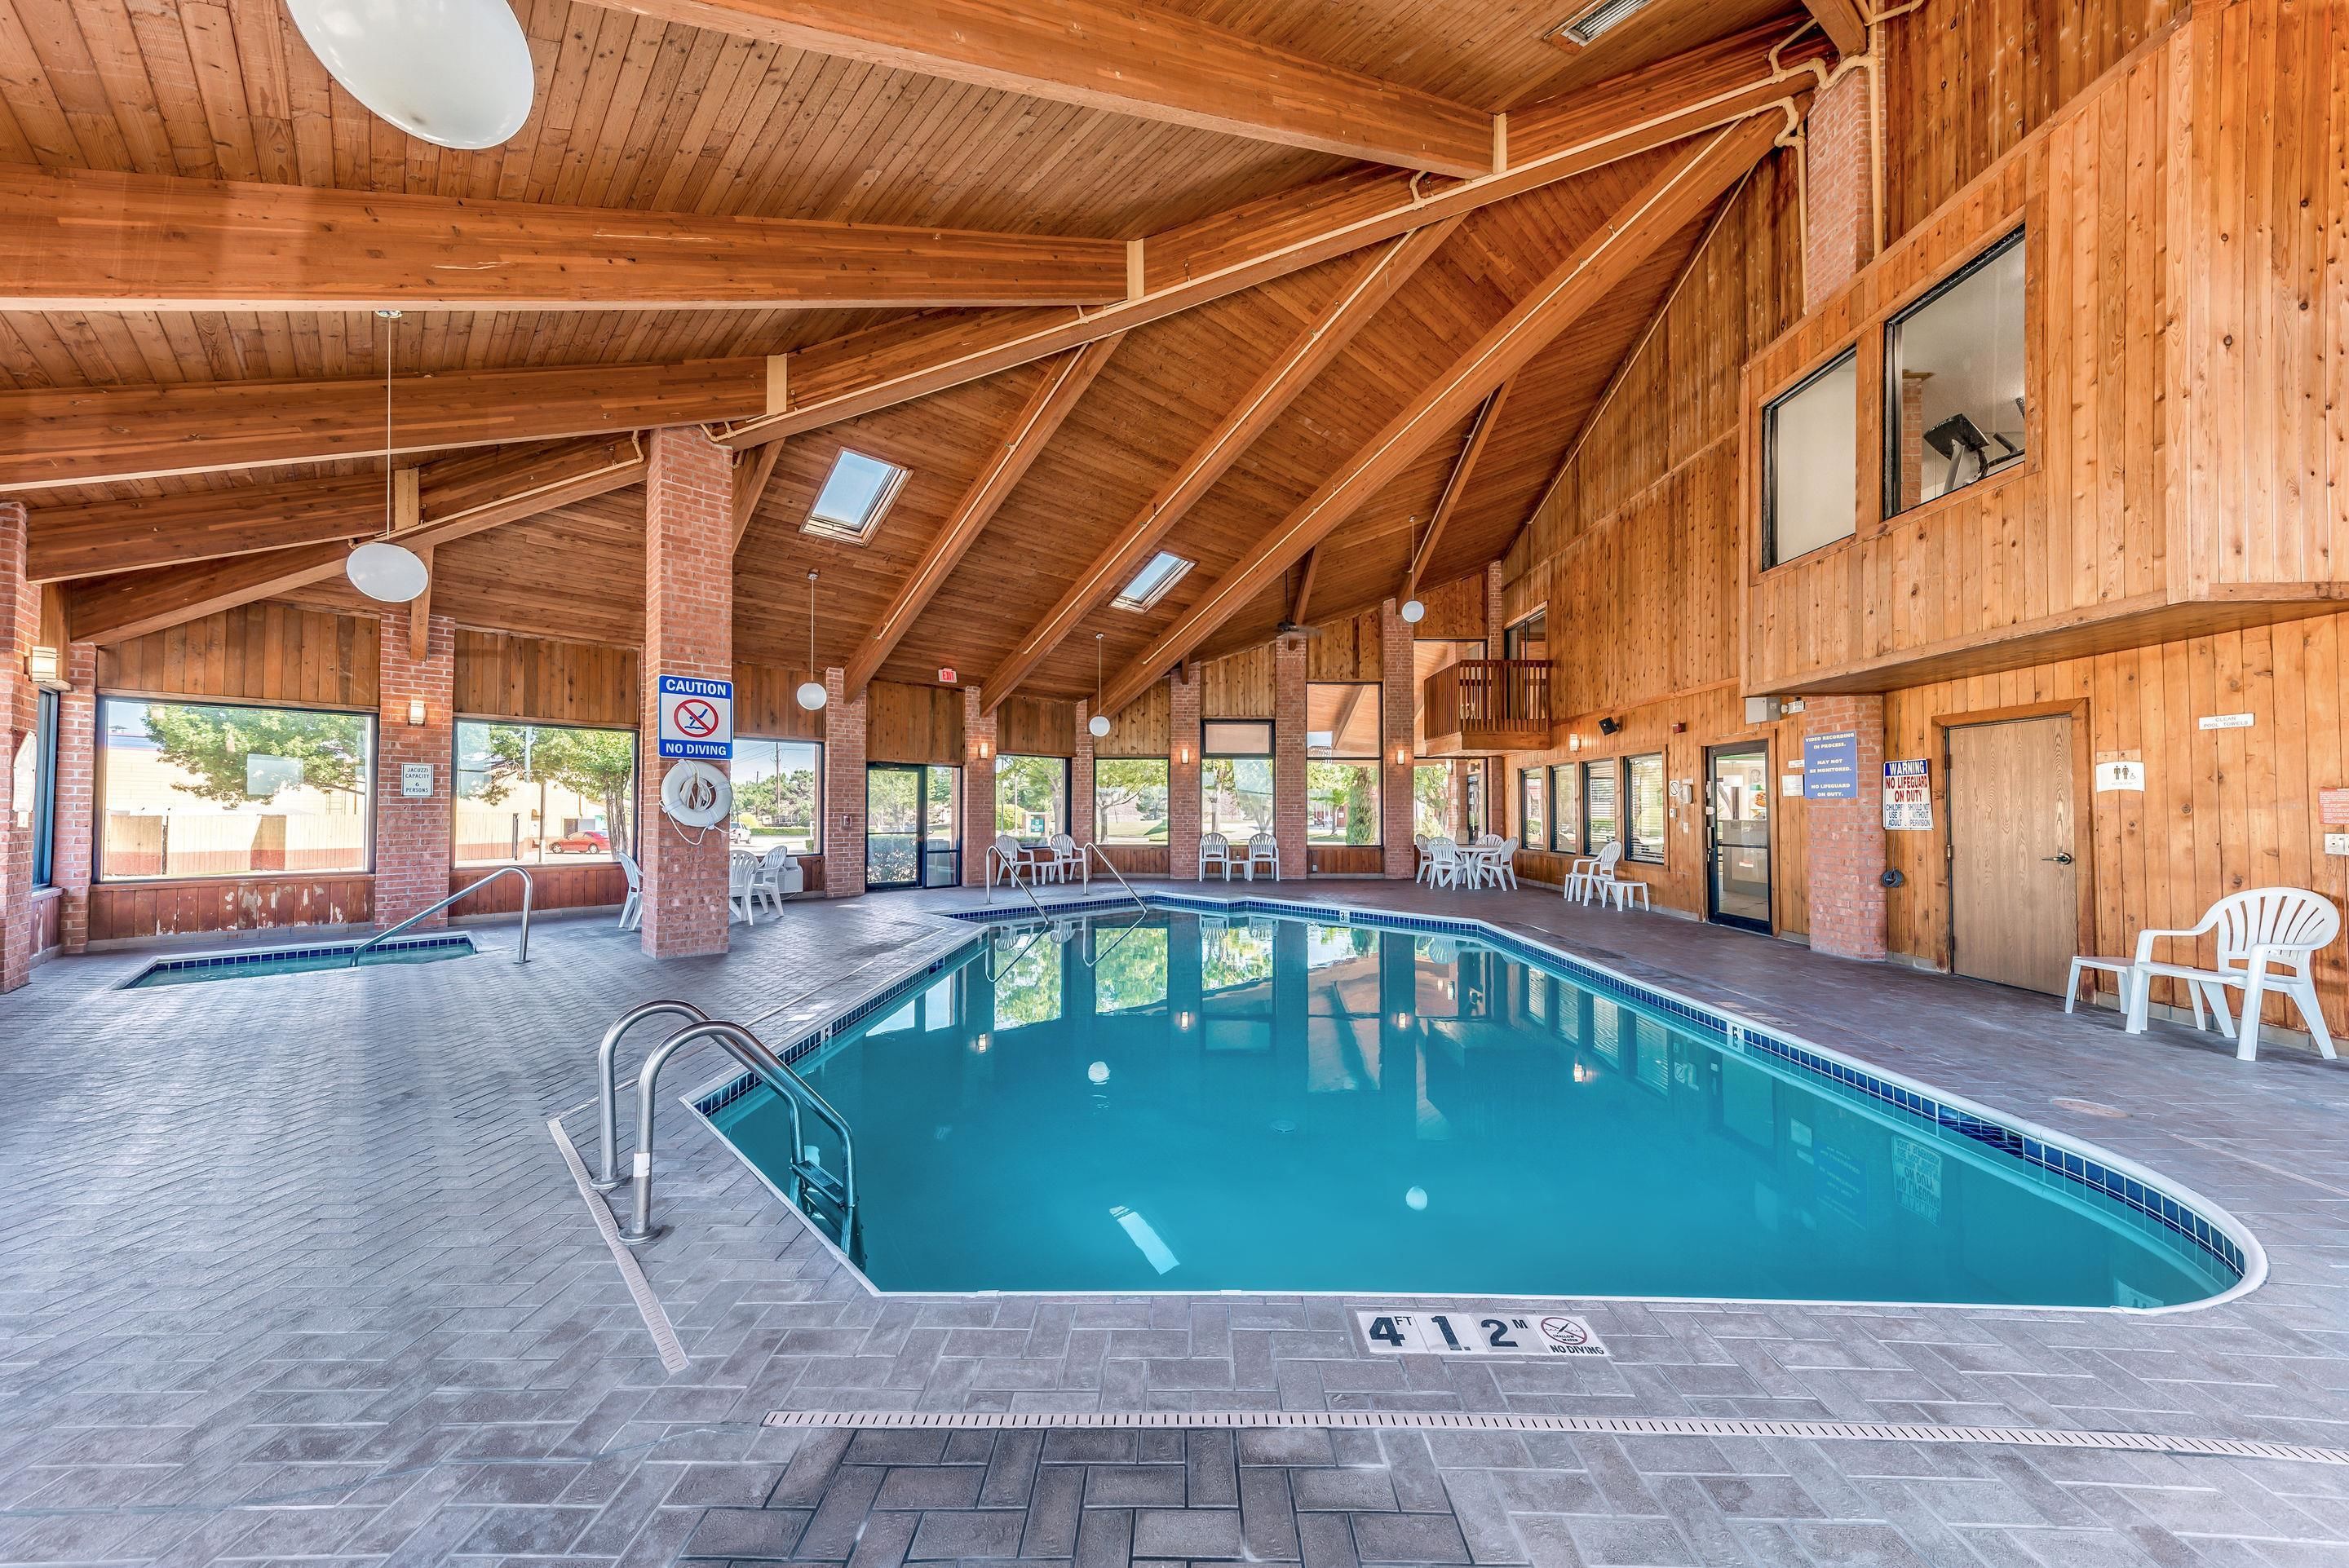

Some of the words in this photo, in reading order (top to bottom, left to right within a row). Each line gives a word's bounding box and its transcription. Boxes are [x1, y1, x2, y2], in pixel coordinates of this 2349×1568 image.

[942, 670, 954, 681] EXIT
[666, 678, 727, 696] CAUTION
[1822, 732, 1855, 741] RECORDING
[666, 743, 683, 754] NO
[686, 744, 727, 756] DIVING
[1889, 760, 1925, 775] WARNING
[1886, 776, 1896, 790] NO
[1897, 775, 1928, 789] LIFEGUARD
[1894, 789, 1904, 803] ON
[1906, 789, 1922, 802] DUTY
[1908, 803, 1922, 811] SHOULD
[1913, 811, 1929, 819] WITHOUT
[1340, 912, 1345, 921] 3
[1369, 1317, 1405, 1346] 4
[1394, 1316, 1412, 1326] FT
[1511, 1319, 1528, 1329] M
[1549, 1345, 1567, 1354] NO
[1566, 1345, 1604, 1355] DIVING
